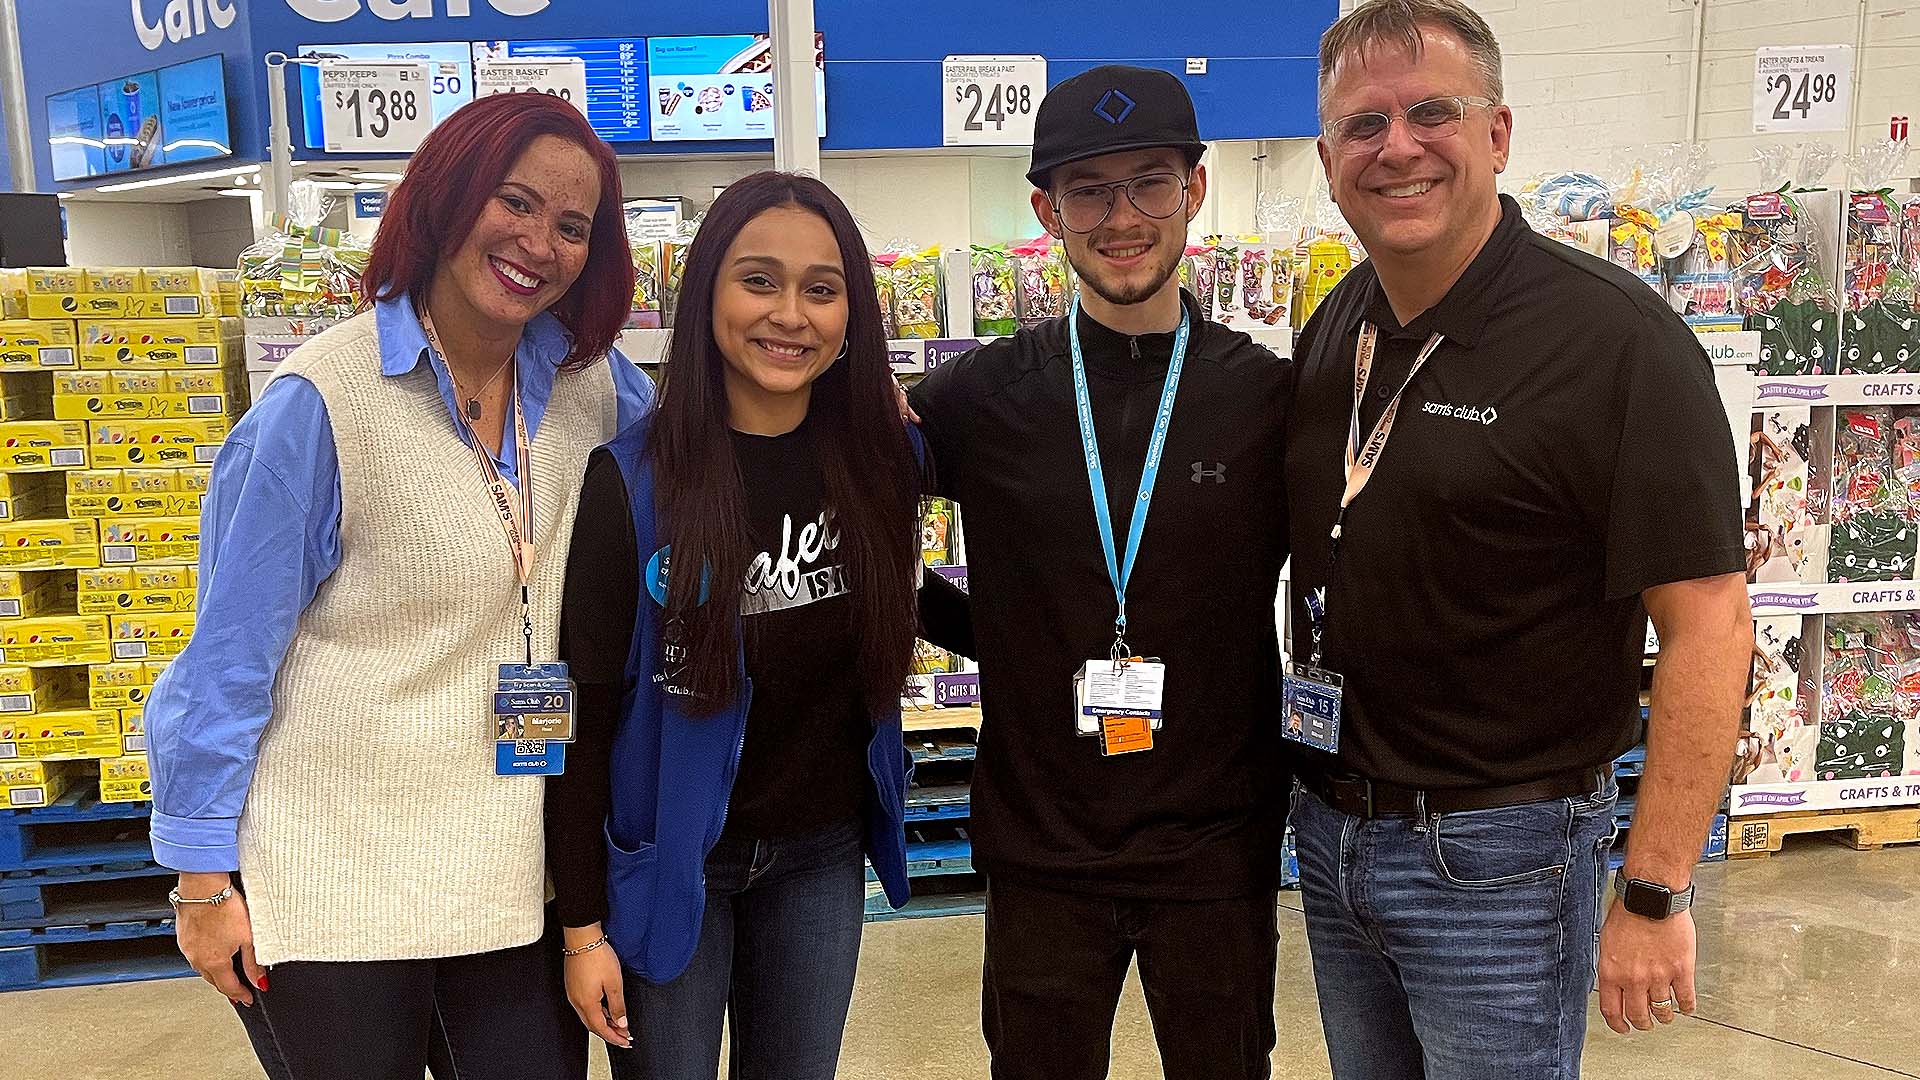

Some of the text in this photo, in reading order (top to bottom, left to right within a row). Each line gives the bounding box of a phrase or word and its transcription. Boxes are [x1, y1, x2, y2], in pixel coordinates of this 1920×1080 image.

[323, 70, 377, 78] PEPSI PEEPS
[515, 68, 549, 76] BASKET
[945, 65, 965, 73] EASTER
[361, 197, 382, 205] Order
[928, 347, 937, 369] 3
[1173, 338, 1185, 377] checkout
[1707, 344, 1753, 359] lub.com
[1075, 369, 1084, 387] Scan
[1863, 383, 1913, 397] CRAFTS
[1163, 390, 1173, 409] Scan
[1421, 401, 1454, 416] sam's
[1081, 407, 1093, 437] checkout
[1085, 438, 1093, 451] the
[1361, 430, 1386, 469] SAM'S
[1088, 451, 1097, 469] Skip
[491, 484, 513, 521] SAM'S
[805, 571, 829, 600] IS
[1852, 589, 1916, 604] CRAFTS &
[938, 681, 947, 701] 3
[949, 684, 967, 697] GIFTS
[544, 694, 564, 708] 20
[1318, 698, 1329, 714] 15
[1091, 707, 1125, 715] Emergency
[531, 717, 562, 726] Marjorie
[1840, 786, 1888, 800] CRAFTS
[1892, 785, 1901, 797] &
